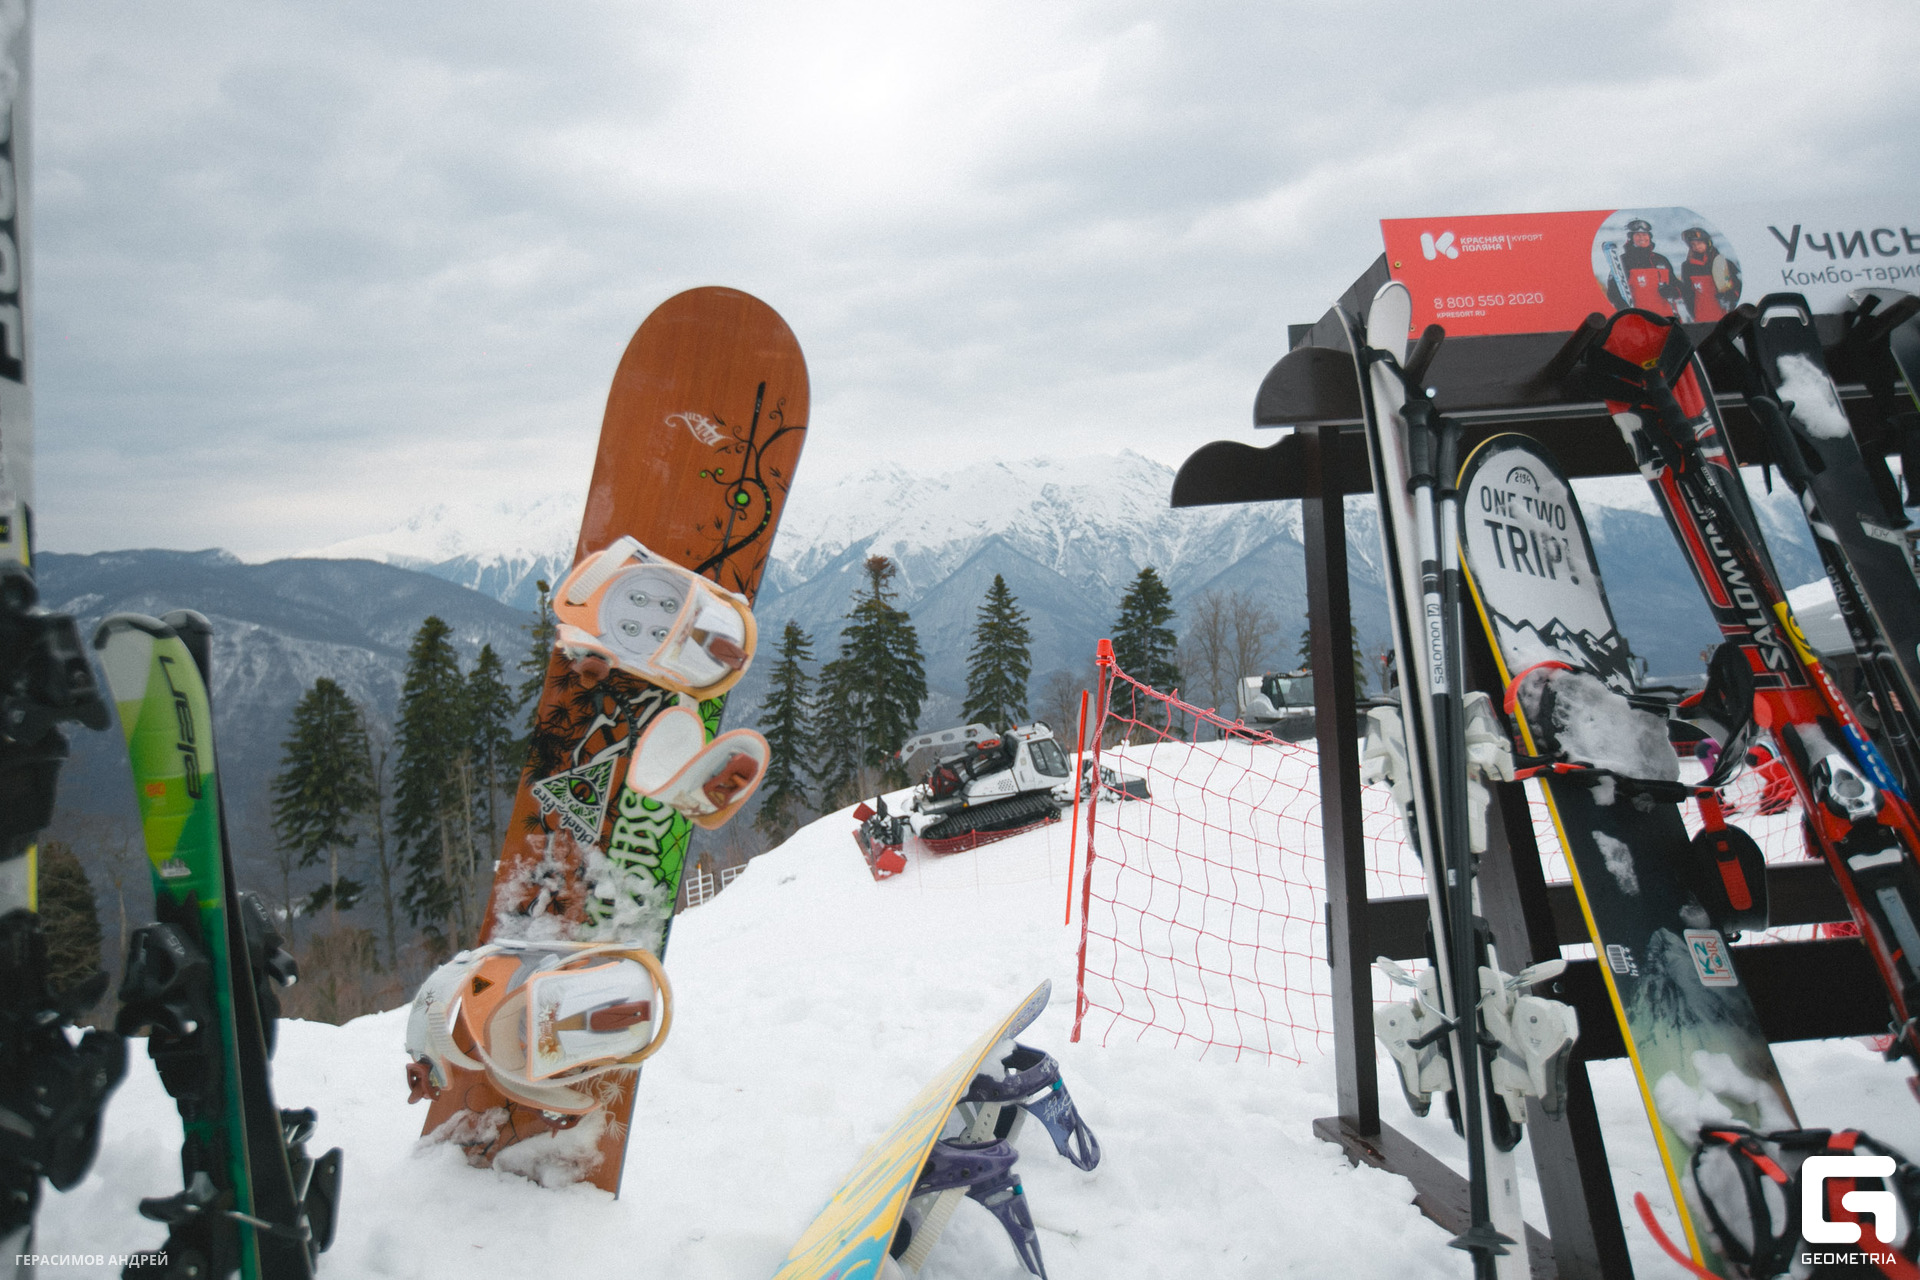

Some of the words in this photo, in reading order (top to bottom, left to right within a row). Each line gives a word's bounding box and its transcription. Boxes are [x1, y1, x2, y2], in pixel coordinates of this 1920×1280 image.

[1460, 235, 1505, 245] КРАСНАЯ
[1511, 234, 1543, 242] КУРОРТ
[1461, 243, 1503, 252] ПОЛЯНА
[1781, 264, 1920, 286] Комбо-тари
[1433, 297, 1444, 310] 8
[1446, 296, 1475, 309] 800
[1478, 294, 1505, 307] 550
[1508, 292, 1544, 306] 2020
[1436, 310, 1486, 319] KPRESORT.RU
[1480, 485, 1518, 519] ONE
[1522, 495, 1567, 531] TWO
[1483, 518, 1580, 586] TRIP!
